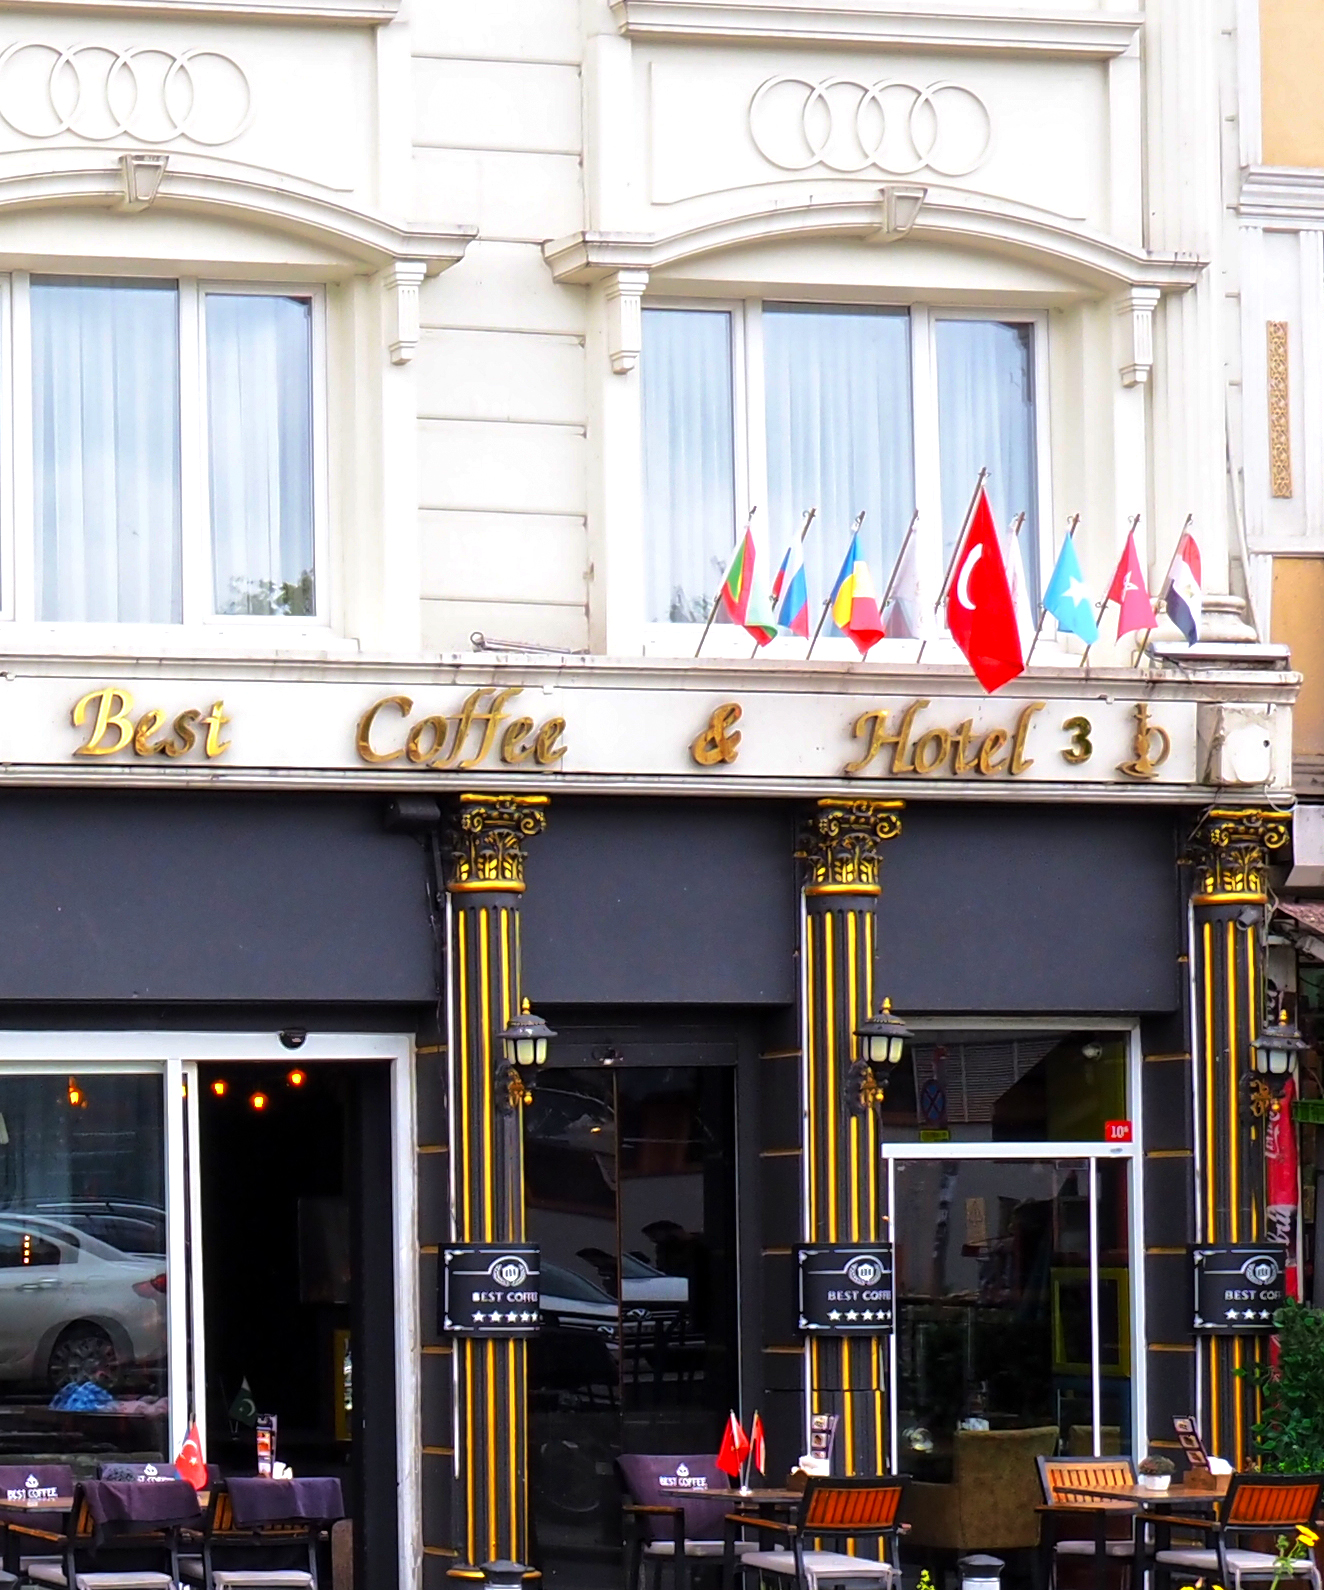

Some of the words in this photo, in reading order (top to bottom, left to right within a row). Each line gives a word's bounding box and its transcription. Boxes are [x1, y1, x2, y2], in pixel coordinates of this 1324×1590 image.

[71, 686, 232, 760] Best
[355, 683, 568, 770] Coffee
[690, 701, 743, 767] &
[843, 698, 1047, 778] Hotel
[1062, 715, 1092, 764] 3
[471, 1291, 504, 1303] BEST
[827, 1290, 860, 1301] BEST
[1224, 1289, 1257, 1301] BEST
